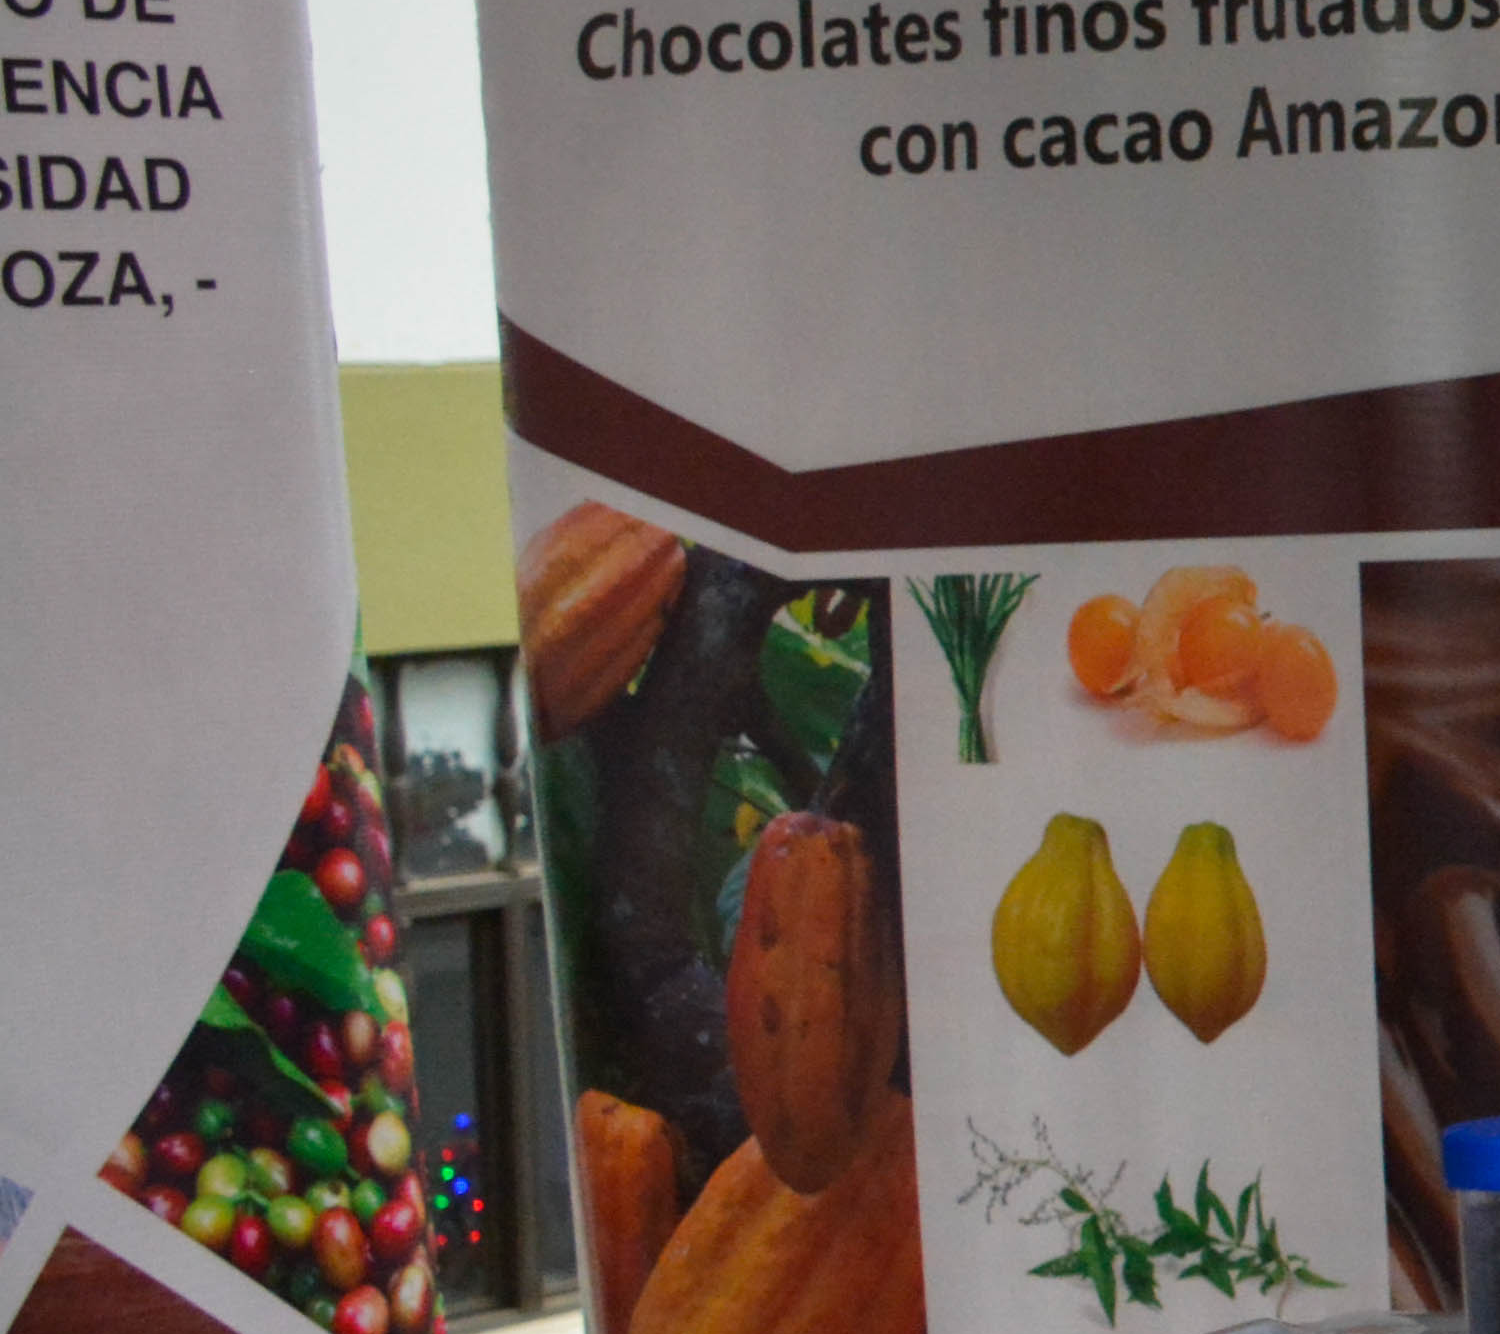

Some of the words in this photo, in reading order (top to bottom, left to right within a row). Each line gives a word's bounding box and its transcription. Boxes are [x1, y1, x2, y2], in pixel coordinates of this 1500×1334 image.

[1, 57, 224, 120] ENCIA
[858, 118, 979, 177] con
[1002, 104, 1215, 171] cacao
[1, 249, 175, 318] OZA,
